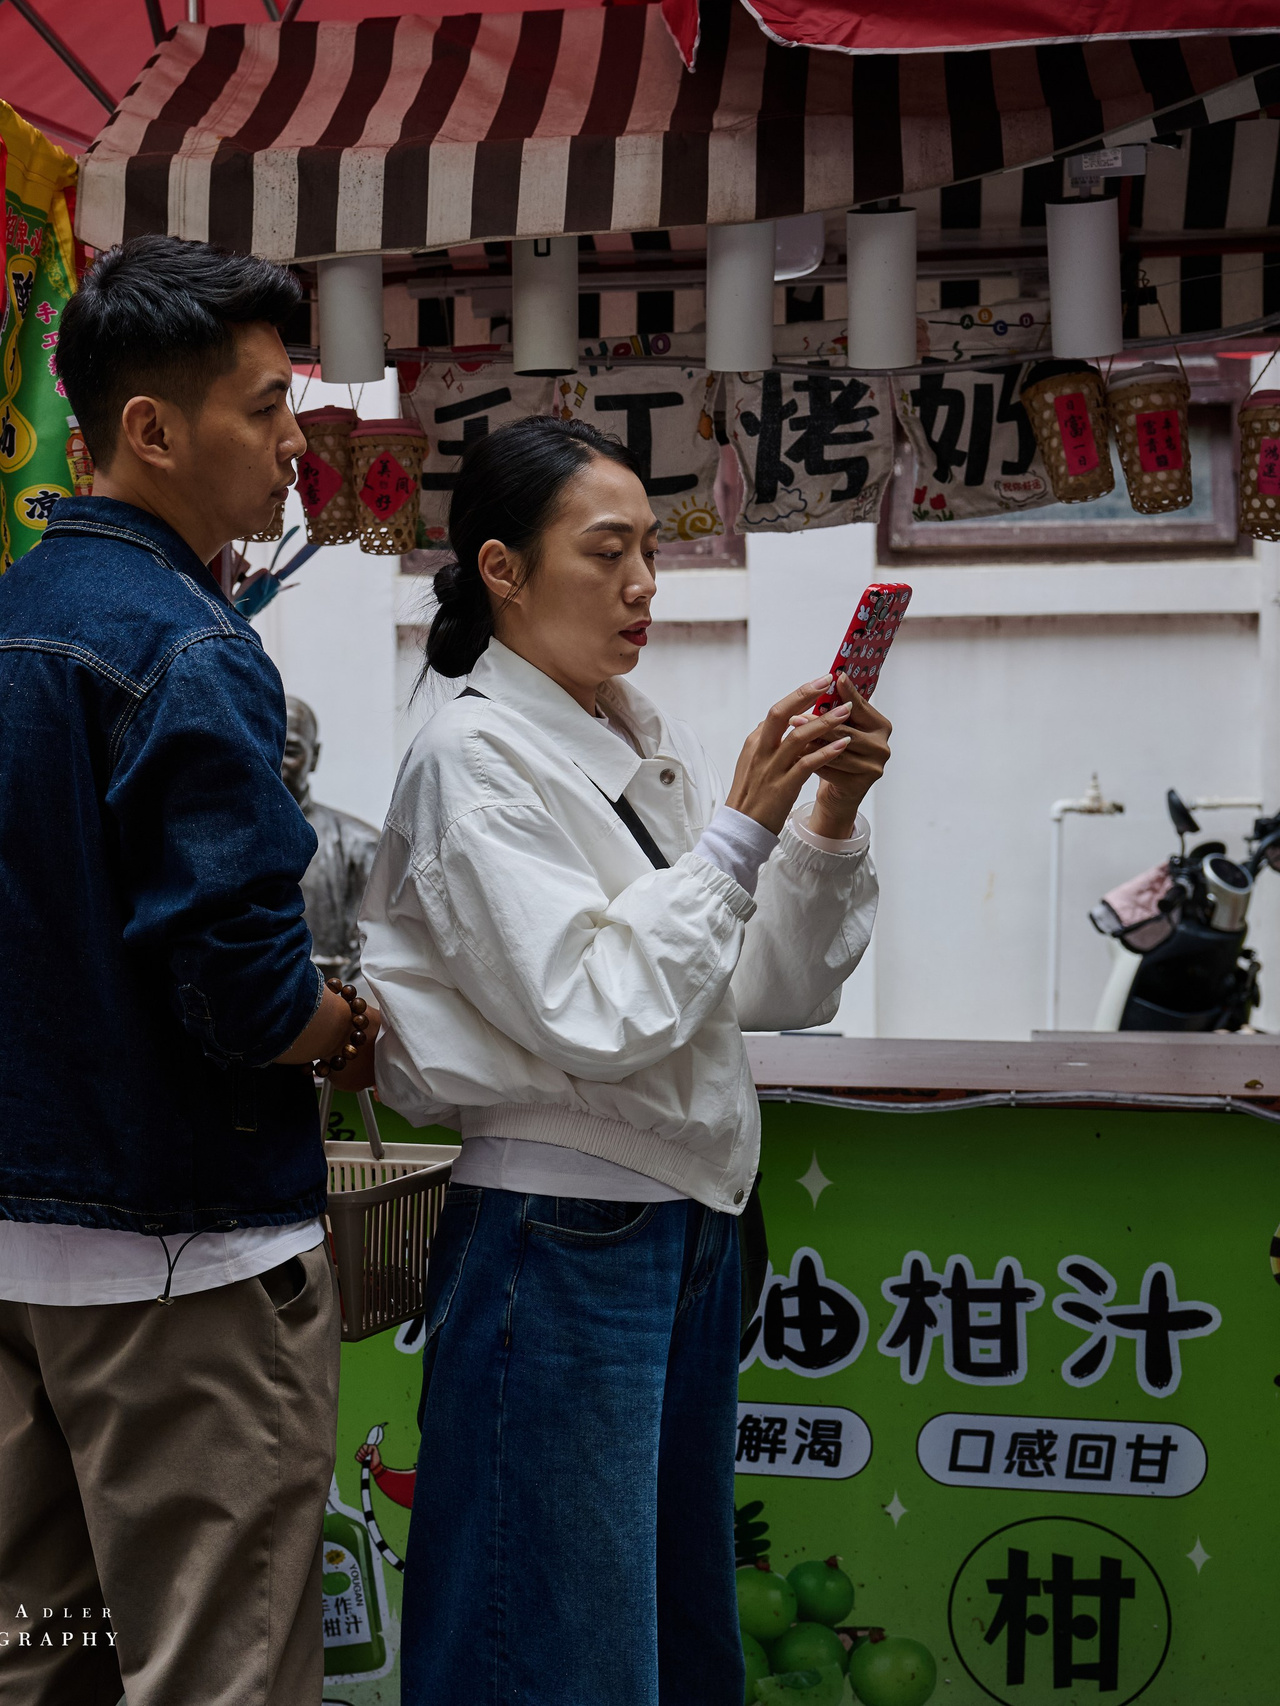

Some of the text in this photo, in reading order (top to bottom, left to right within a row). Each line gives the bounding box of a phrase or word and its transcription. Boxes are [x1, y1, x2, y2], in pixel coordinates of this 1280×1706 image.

[740, 1255, 1213, 1390] 油柑汁
[735, 1414, 843, 1468] 解渴
[949, 1429, 1178, 1484] 口感回甘
[349, 1563, 364, 1607] YOUGAN
